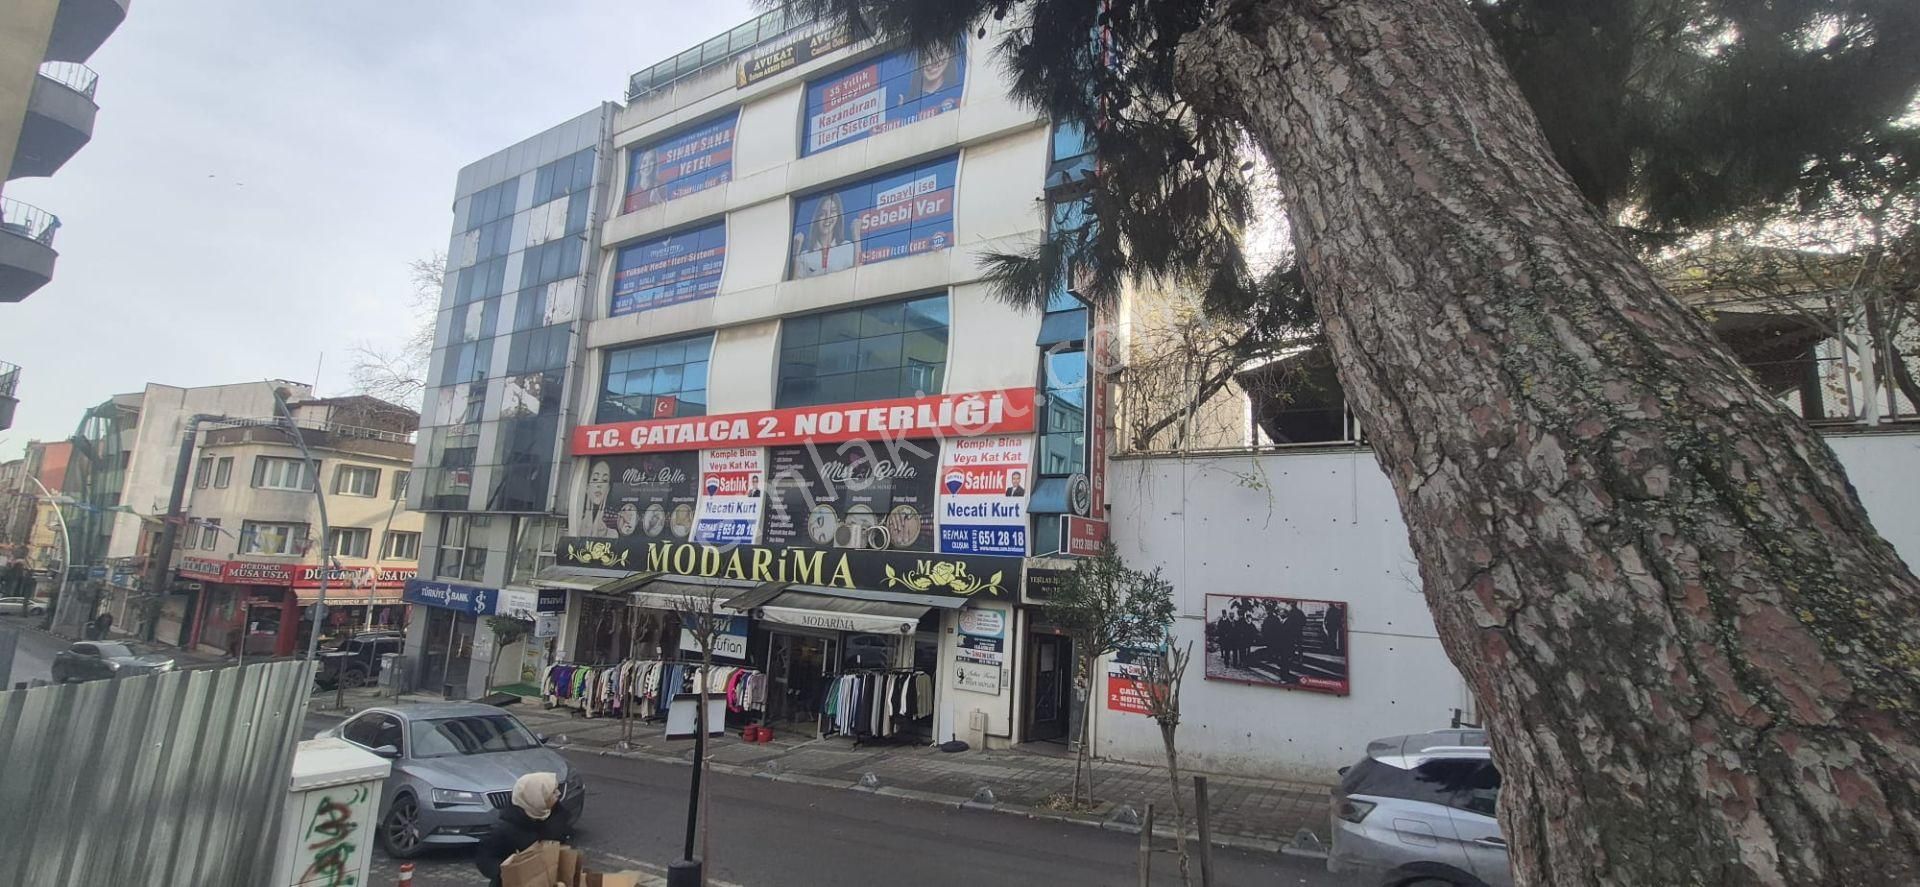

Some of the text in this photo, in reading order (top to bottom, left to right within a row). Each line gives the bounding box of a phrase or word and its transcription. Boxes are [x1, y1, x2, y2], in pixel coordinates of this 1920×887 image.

[753, 46, 794, 71] AVUKAT
[818, 97, 877, 128] Kazandıran
[843, 114, 879, 136] Sistem
[666, 142, 698, 163] SINAV
[679, 155, 712, 175] YETER
[919, 181, 935, 192] ise
[861, 199, 944, 229] Sebebi Var
[690, 250, 715, 261] Sistem
[586, 392, 1004, 449] T.C. ÇATALCA 2. NOTERLİĞİ
[956, 437, 1022, 450] Komple Bina
[710, 448, 756, 459] Komple Bina
[954, 451, 1022, 464] Veya Kat Kat
[710, 461, 757, 471] Veya Kat Kat
[820, 462, 858, 482] Miss
[873, 459, 917, 480] Bella
[622, 467, 648, 486] Miss
[658, 466, 686, 484] Bella
[965, 471, 1003, 489] Satılık
[720, 476, 748, 492] Satılık
[705, 502, 757, 513] Necati Kurt
[947, 503, 1020, 517] Necati Kurt
[723, 523, 735, 535] 651
[736, 523, 745, 536] 28
[943, 529, 969, 540] RE/MAX
[979, 531, 1024, 547] 651 28 18
[229, 568, 291, 580] MUSA USTA
[421, 585, 445, 599] TÜRKİYE
